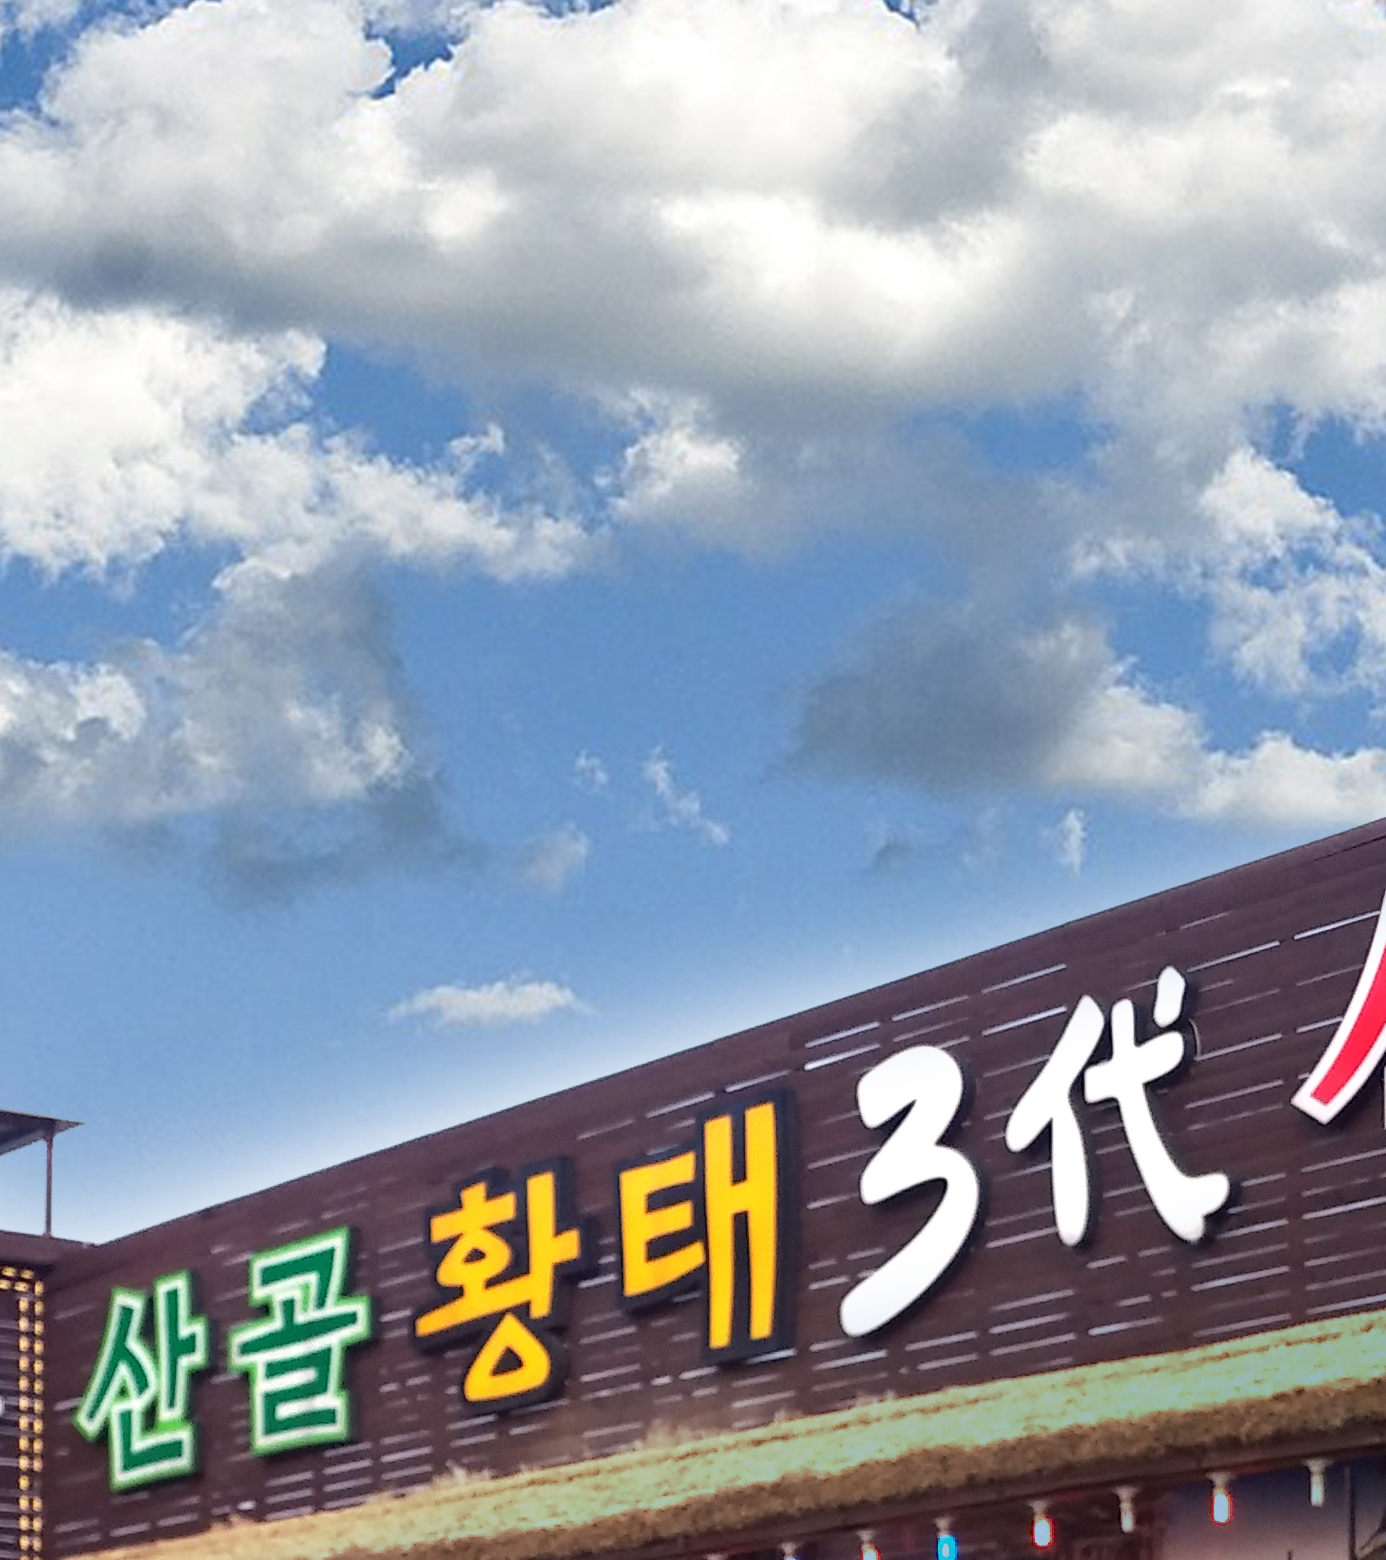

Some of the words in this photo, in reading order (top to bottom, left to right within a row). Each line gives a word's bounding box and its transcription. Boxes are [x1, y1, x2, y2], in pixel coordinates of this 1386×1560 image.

[73, 1226, 373, 1492] 산골
[415, 1102, 778, 1403] 황태
[839, 966, 1230, 1338] 3代
